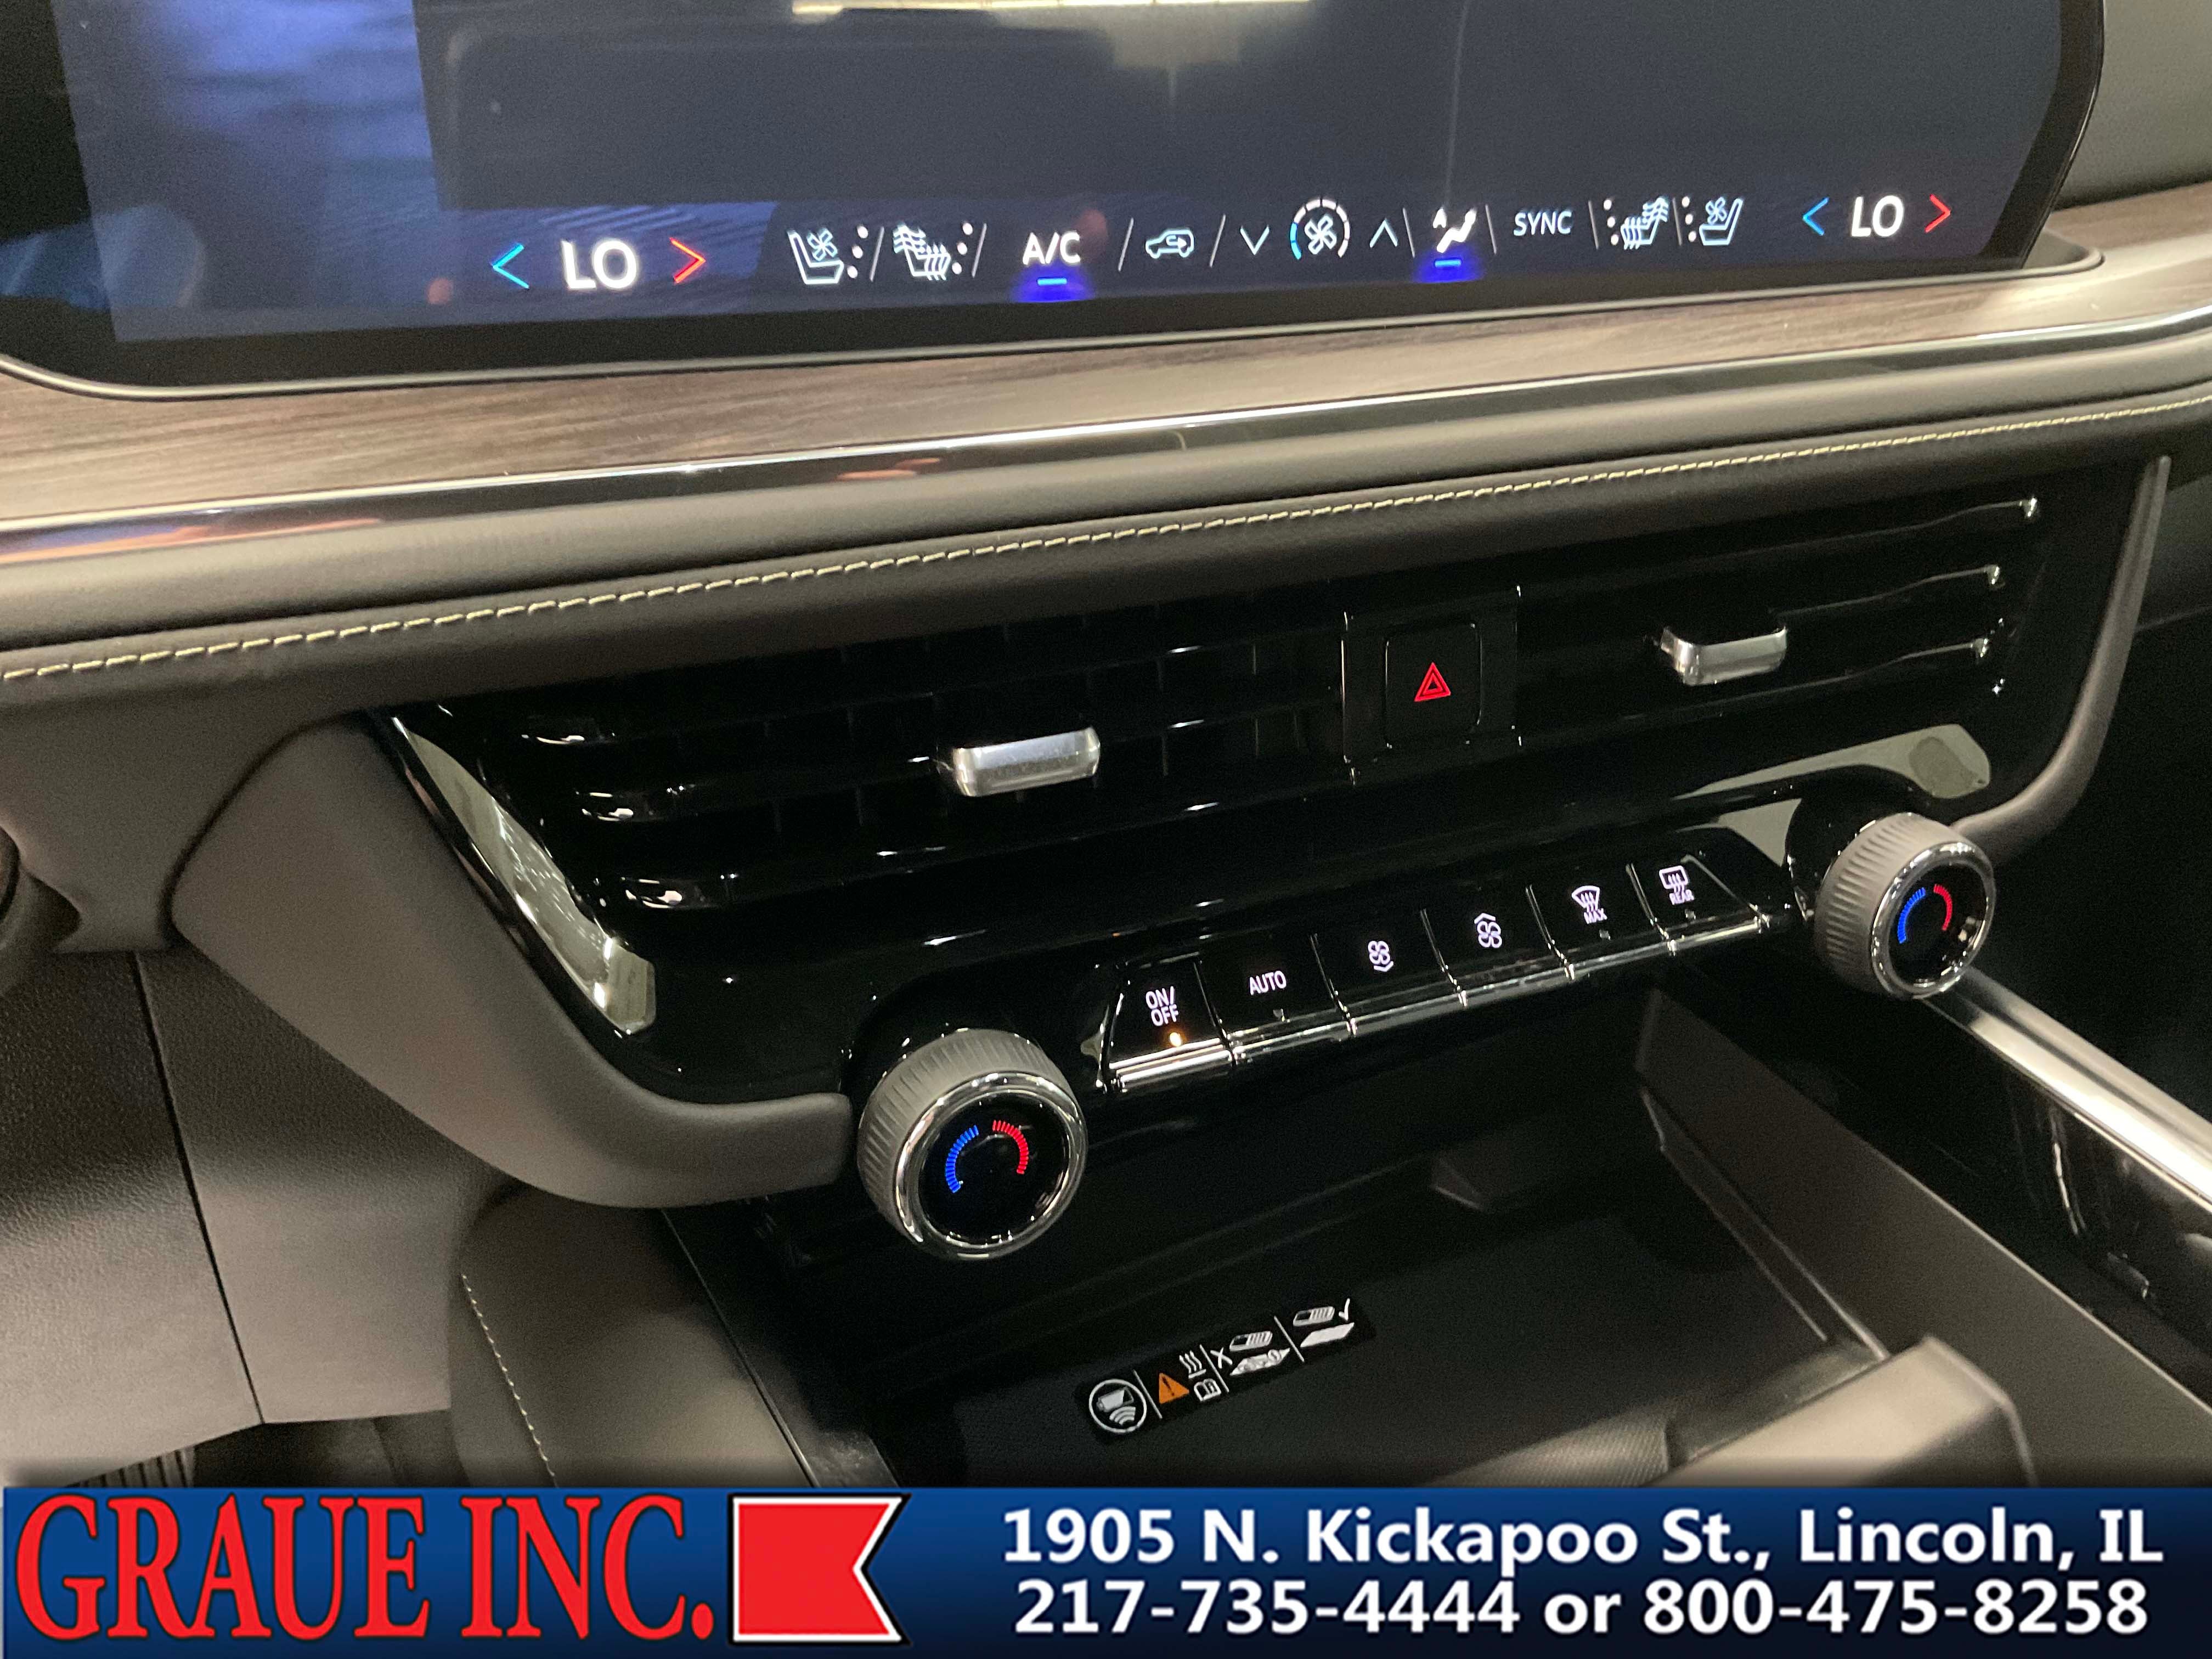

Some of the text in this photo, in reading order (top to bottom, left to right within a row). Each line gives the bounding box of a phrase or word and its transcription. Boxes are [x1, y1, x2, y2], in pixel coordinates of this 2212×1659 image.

[1513, 210, 1572, 238] SYNC
[1851, 195, 1904, 238] LO
[1023, 231, 1082, 267] A/C
[561, 239, 639, 291] LO
[1249, 970, 1286, 996] AUTO
[1146, 986, 1176, 1010] ON/
[1150, 1004, 1179, 1026] OFF
